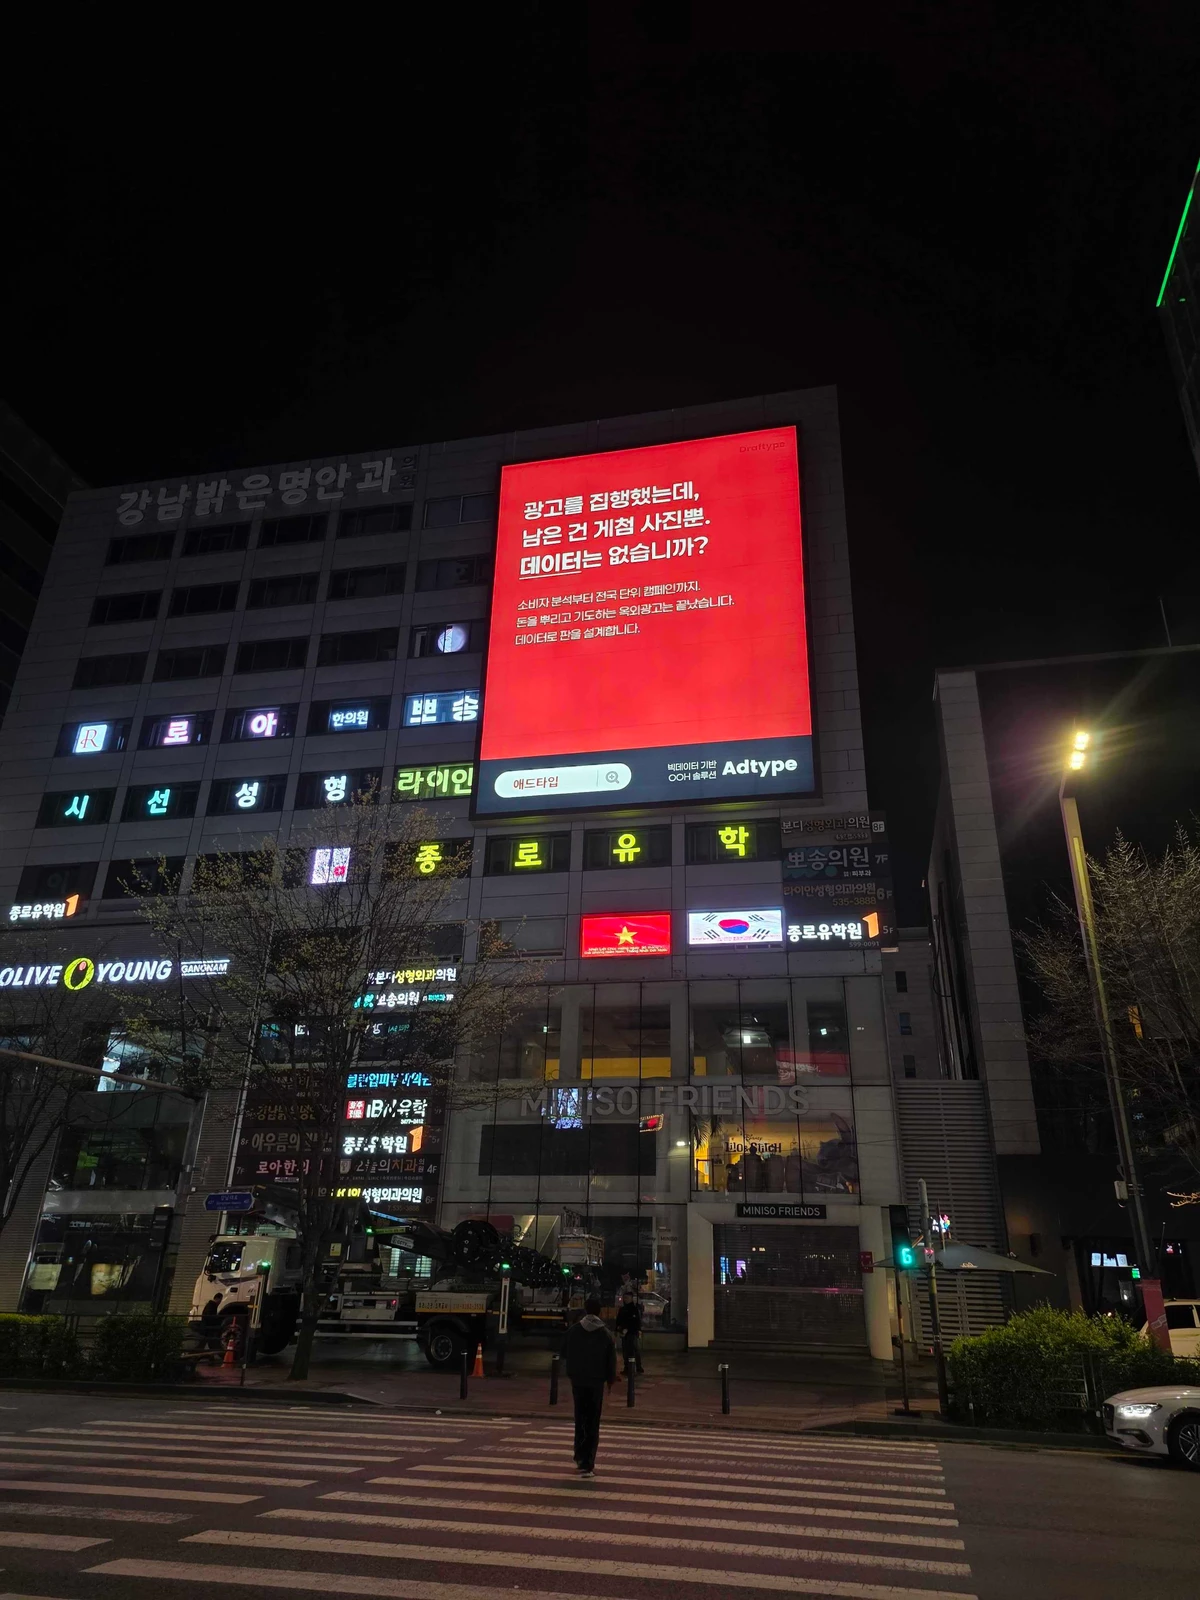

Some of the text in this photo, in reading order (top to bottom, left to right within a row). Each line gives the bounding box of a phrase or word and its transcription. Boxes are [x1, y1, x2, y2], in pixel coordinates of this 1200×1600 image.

[523, 481, 700, 520] 광고를 집행했는데,
[522, 507, 711, 548] 남은 건 게첨 사진뿐.
[520, 536, 709, 577] 데이터는 없습니까?
[517, 597, 550, 611] 소비자
[551, 592, 594, 607] 분석부터
[595, 588, 617, 603] 전국
[619, 586, 641, 600] 단위
[516, 594, 735, 629] 돈을 뿌리고 기도하는 옥외광고는 끝났습니다.
[515, 622, 641, 646] 데이터로 판을 설계합니다.
[332, 710, 369, 727] 한의원
[667, 759, 717, 772] 빅데이터 기반
[722, 757, 798, 778] Adtype
[512, 775, 559, 790] 애드타입
[668, 770, 717, 782] OOH 솔루션
[873, 821, 885, 832] 8F
[875, 854, 888, 864] 7F
[876, 887, 893, 900] 6F
[9, 902, 66, 921] 종로유학원
[787, 922, 863, 943] 종로유학원
[883, 925, 894, 934] 5F
[0, 965, 63, 987] OLIVE
[96, 959, 173, 982] YOUNG
[654, 1085, 810, 1116] FRIENDS
[427, 1164, 438, 1174] 4F
[742, 1205, 821, 1217] MINISO FRIENDS
[901, 1247, 913, 1266] 6
